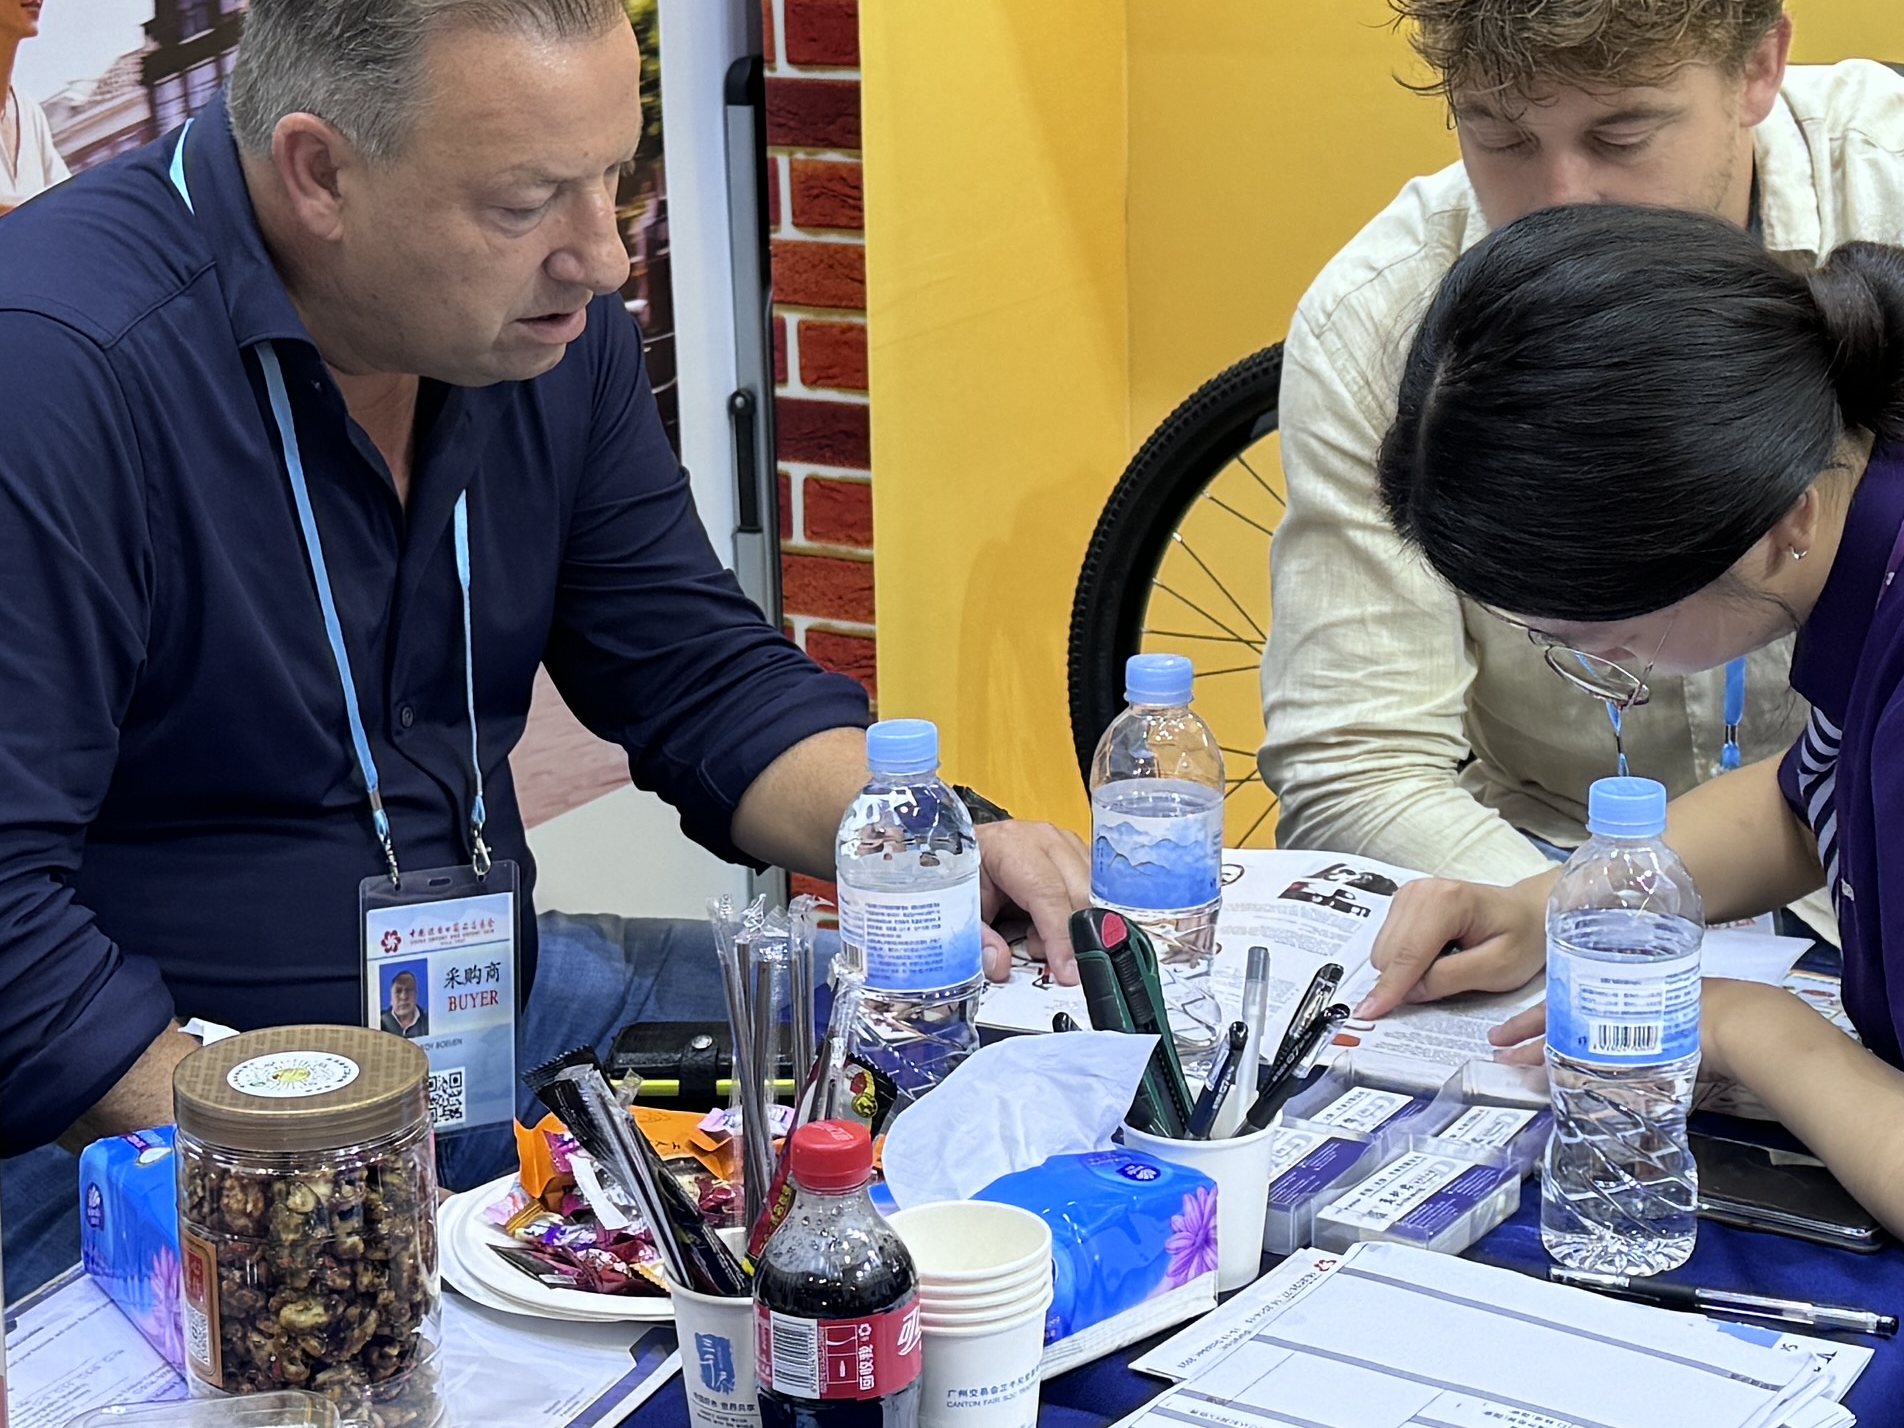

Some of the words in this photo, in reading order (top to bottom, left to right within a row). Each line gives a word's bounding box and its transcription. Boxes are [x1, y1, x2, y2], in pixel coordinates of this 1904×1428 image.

[445, 961, 501, 990] 采购商
[448, 990, 499, 1013] BUYER
